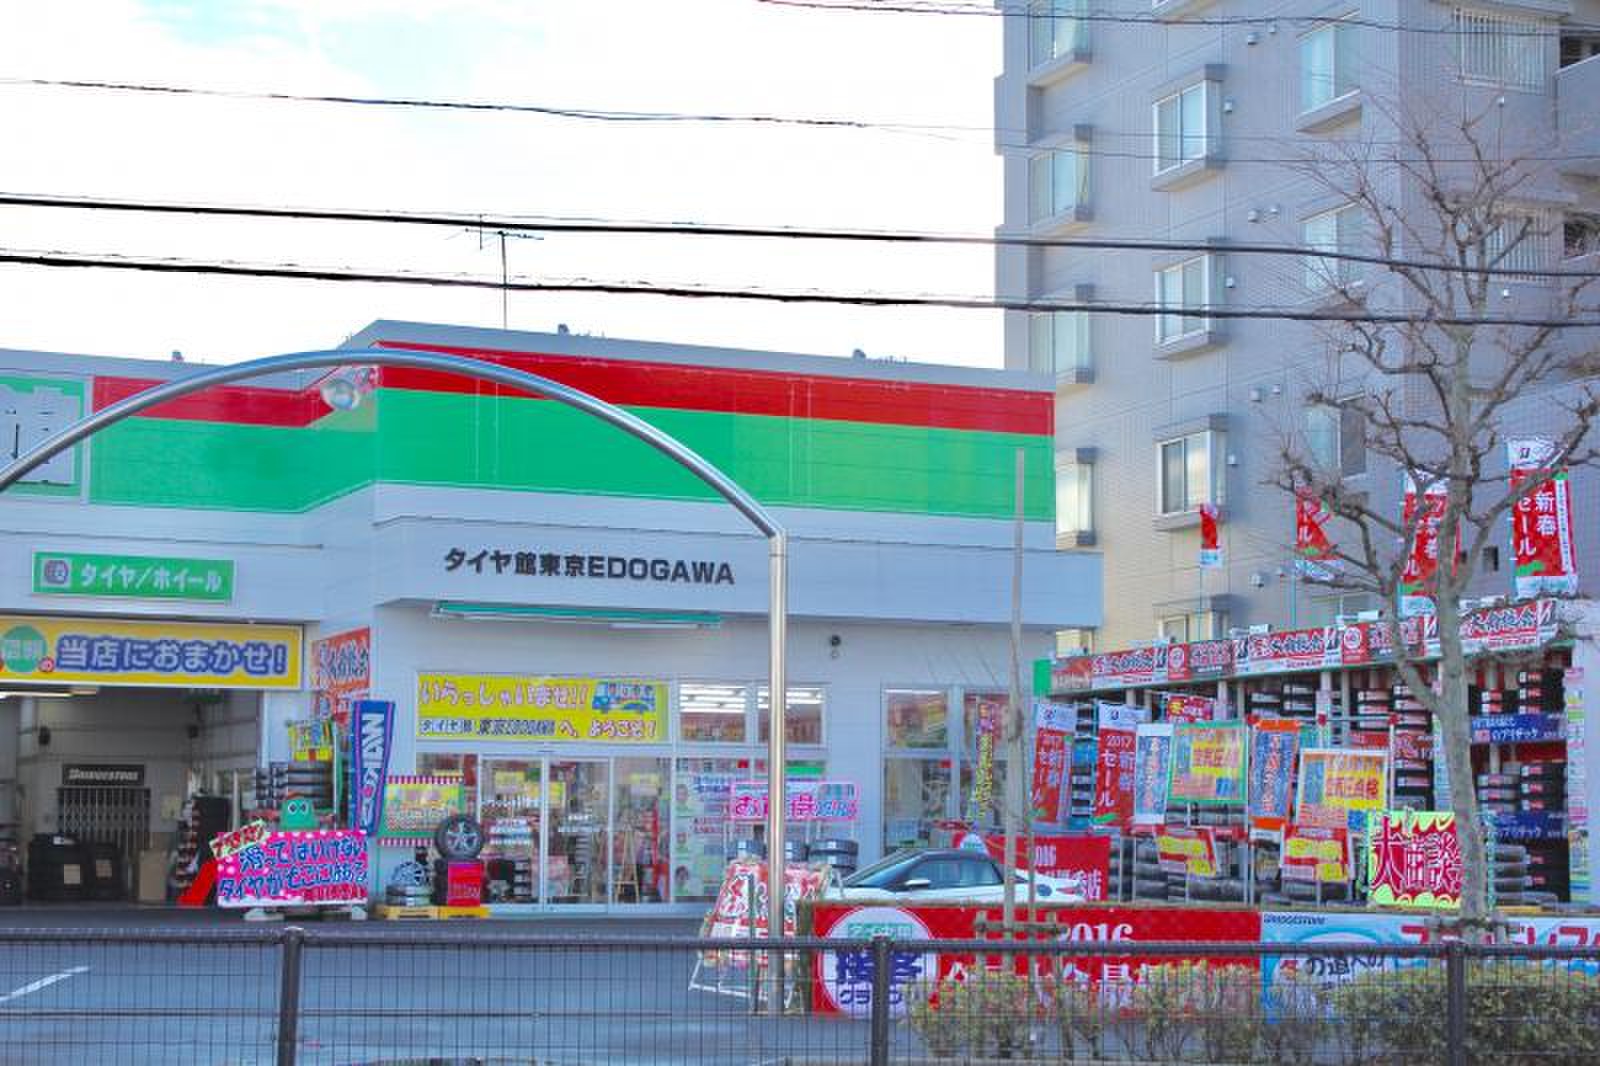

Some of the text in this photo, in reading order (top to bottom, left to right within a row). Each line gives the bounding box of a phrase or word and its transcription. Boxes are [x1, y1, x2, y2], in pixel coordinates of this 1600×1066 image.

[444, 548, 735, 585] タイヤ館東京EDOGAWA
